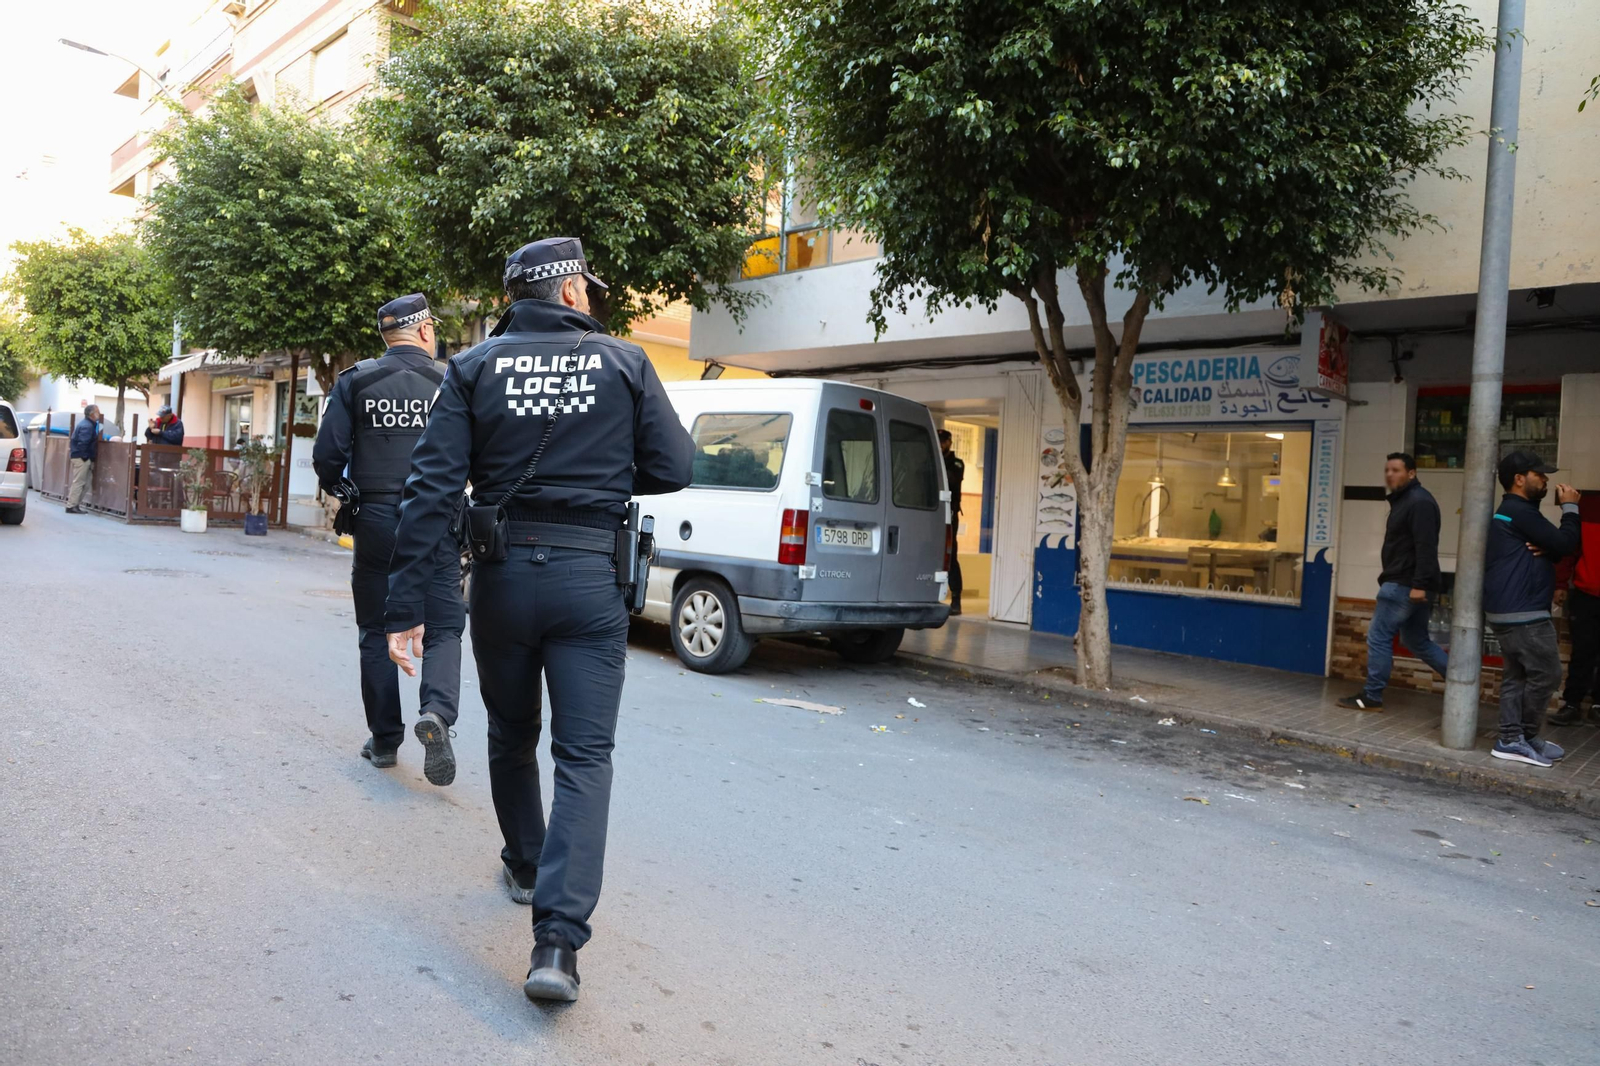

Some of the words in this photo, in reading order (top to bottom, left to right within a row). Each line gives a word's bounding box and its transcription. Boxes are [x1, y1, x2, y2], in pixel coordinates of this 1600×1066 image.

[495, 354, 602, 374] POLICIA
[1134, 355, 1261, 385] PESCADERIA
[505, 374, 596, 395] LOCAL
[1143, 386, 1212, 404] CALIDAD
[365, 399, 429, 414] POLICI
[1220, 399, 1272, 418] الجودة
[1317, 439, 1332, 498] PESCADERIA
[1315, 502, 1329, 541] CALIDAD
[824, 529, 848, 545] 5798
[851, 532, 868, 546] DRP
